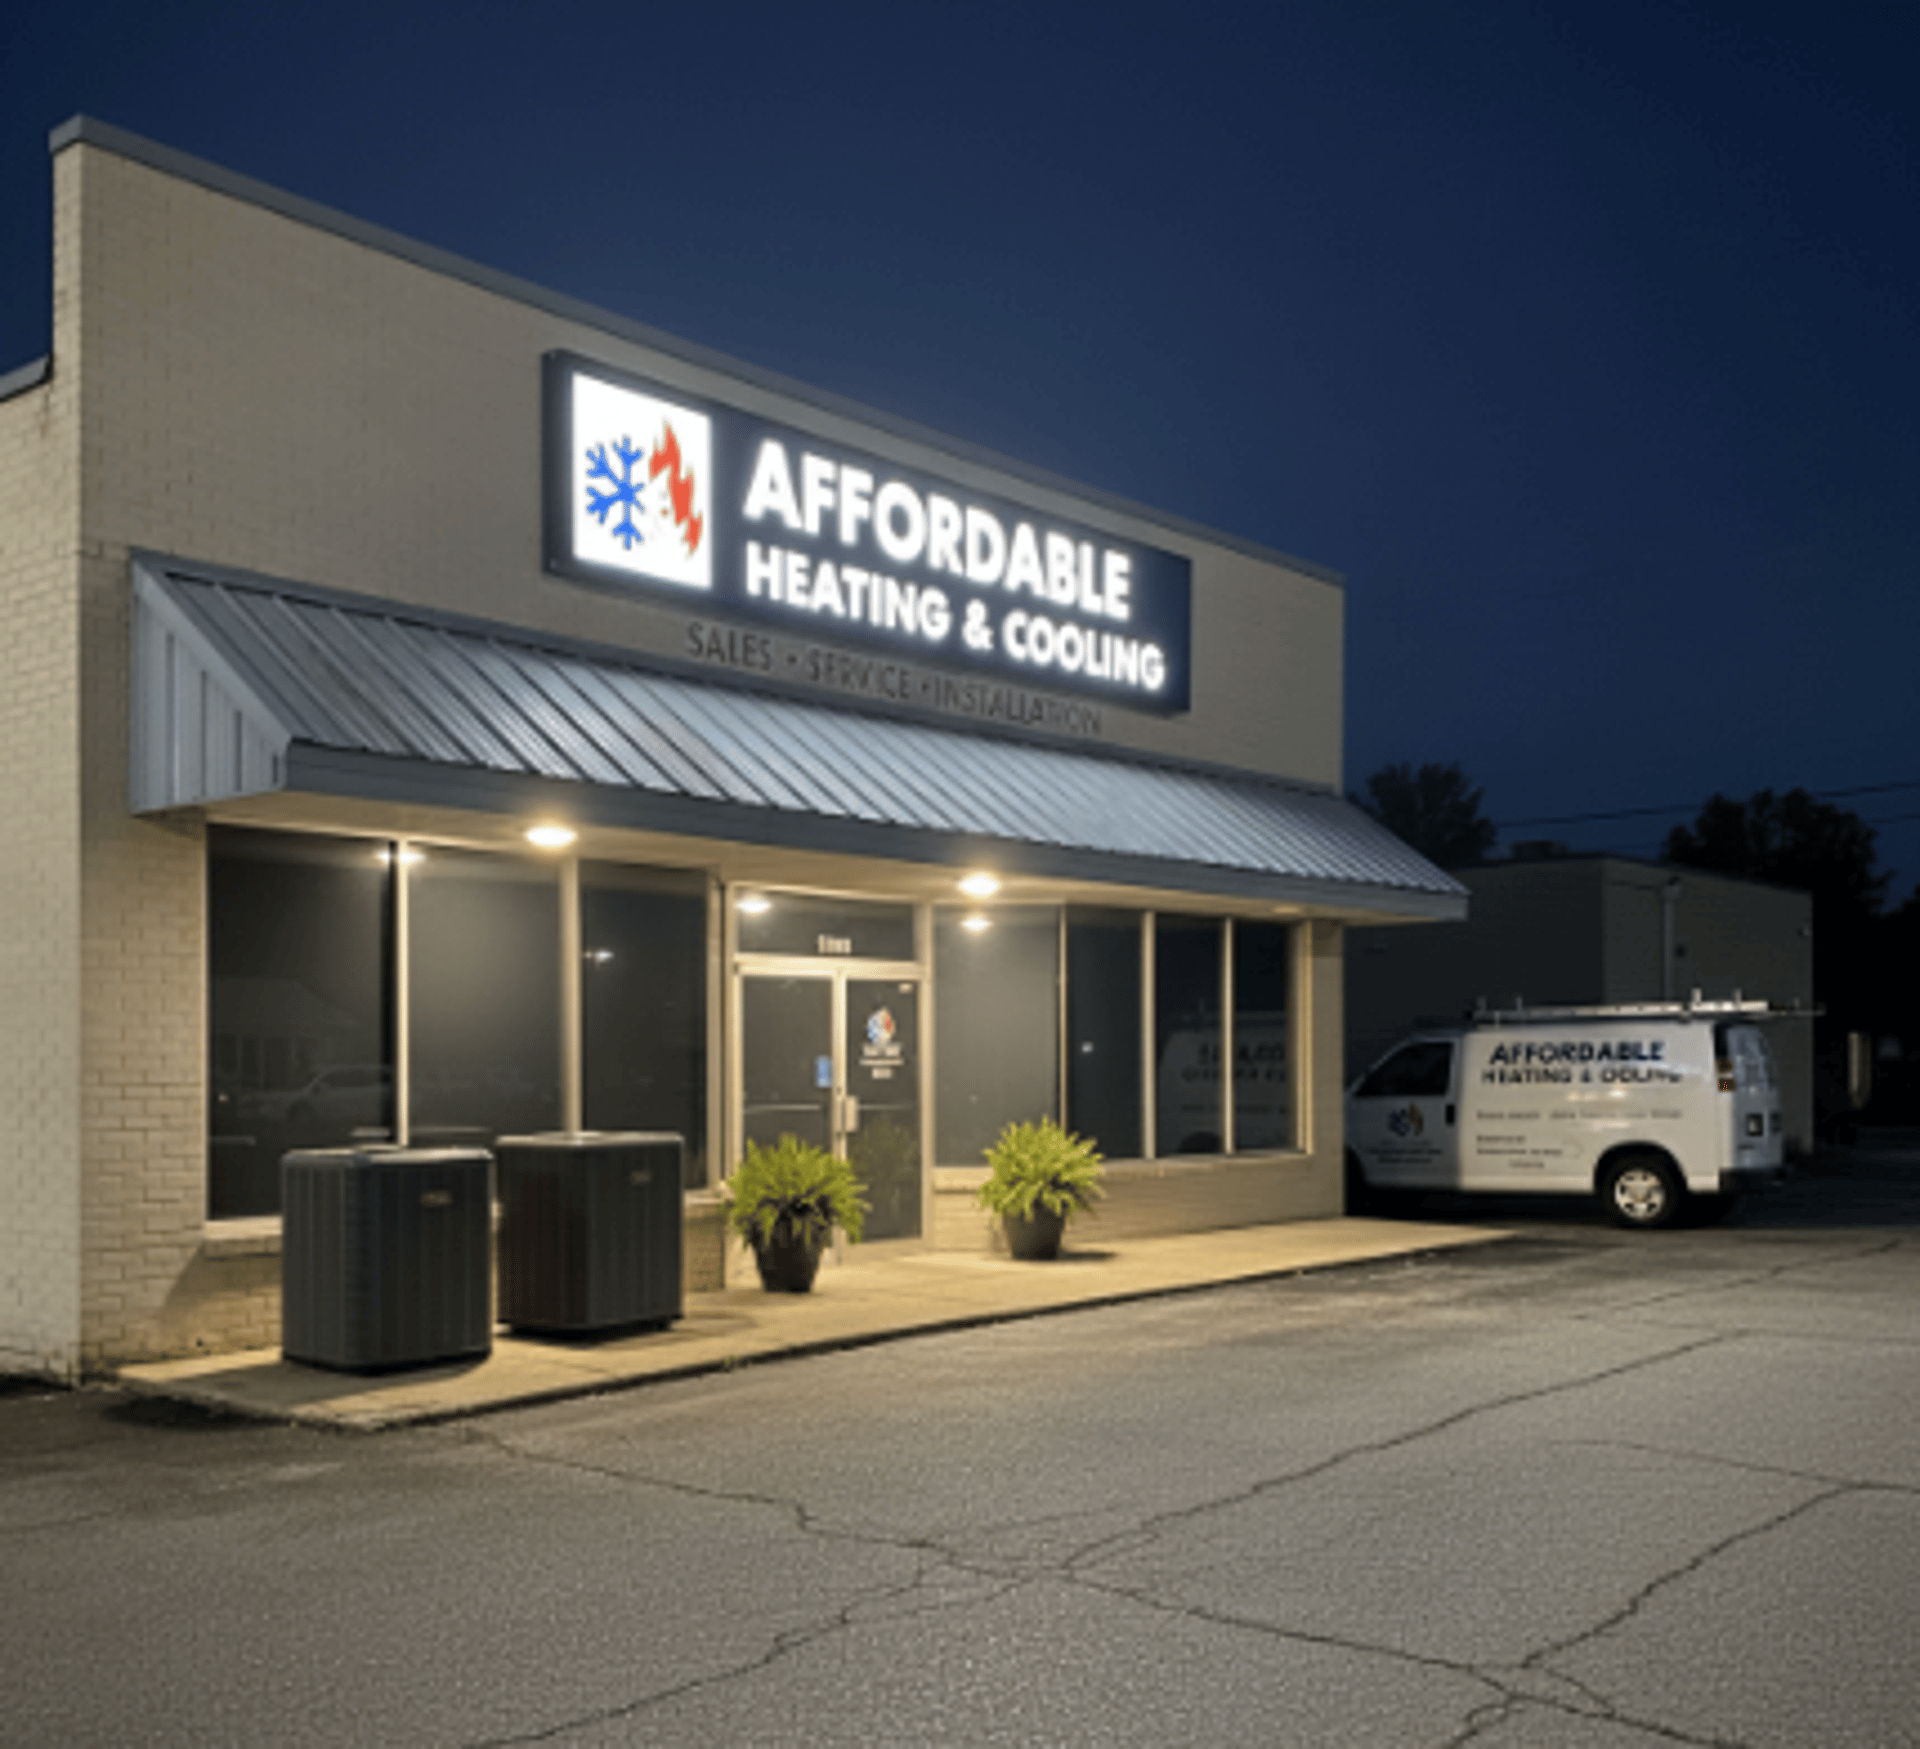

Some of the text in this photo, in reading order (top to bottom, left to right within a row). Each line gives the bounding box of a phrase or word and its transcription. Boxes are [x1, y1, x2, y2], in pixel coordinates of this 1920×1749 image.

[742, 437, 1131, 621] AFFORDABLE
[688, 621, 772, 672] SALES
[809, 649, 910, 699] SERVICE
[746, 540, 1166, 690] HEATING & COOLING
[1489, 1041, 1665, 1065] AFFORDABLE
